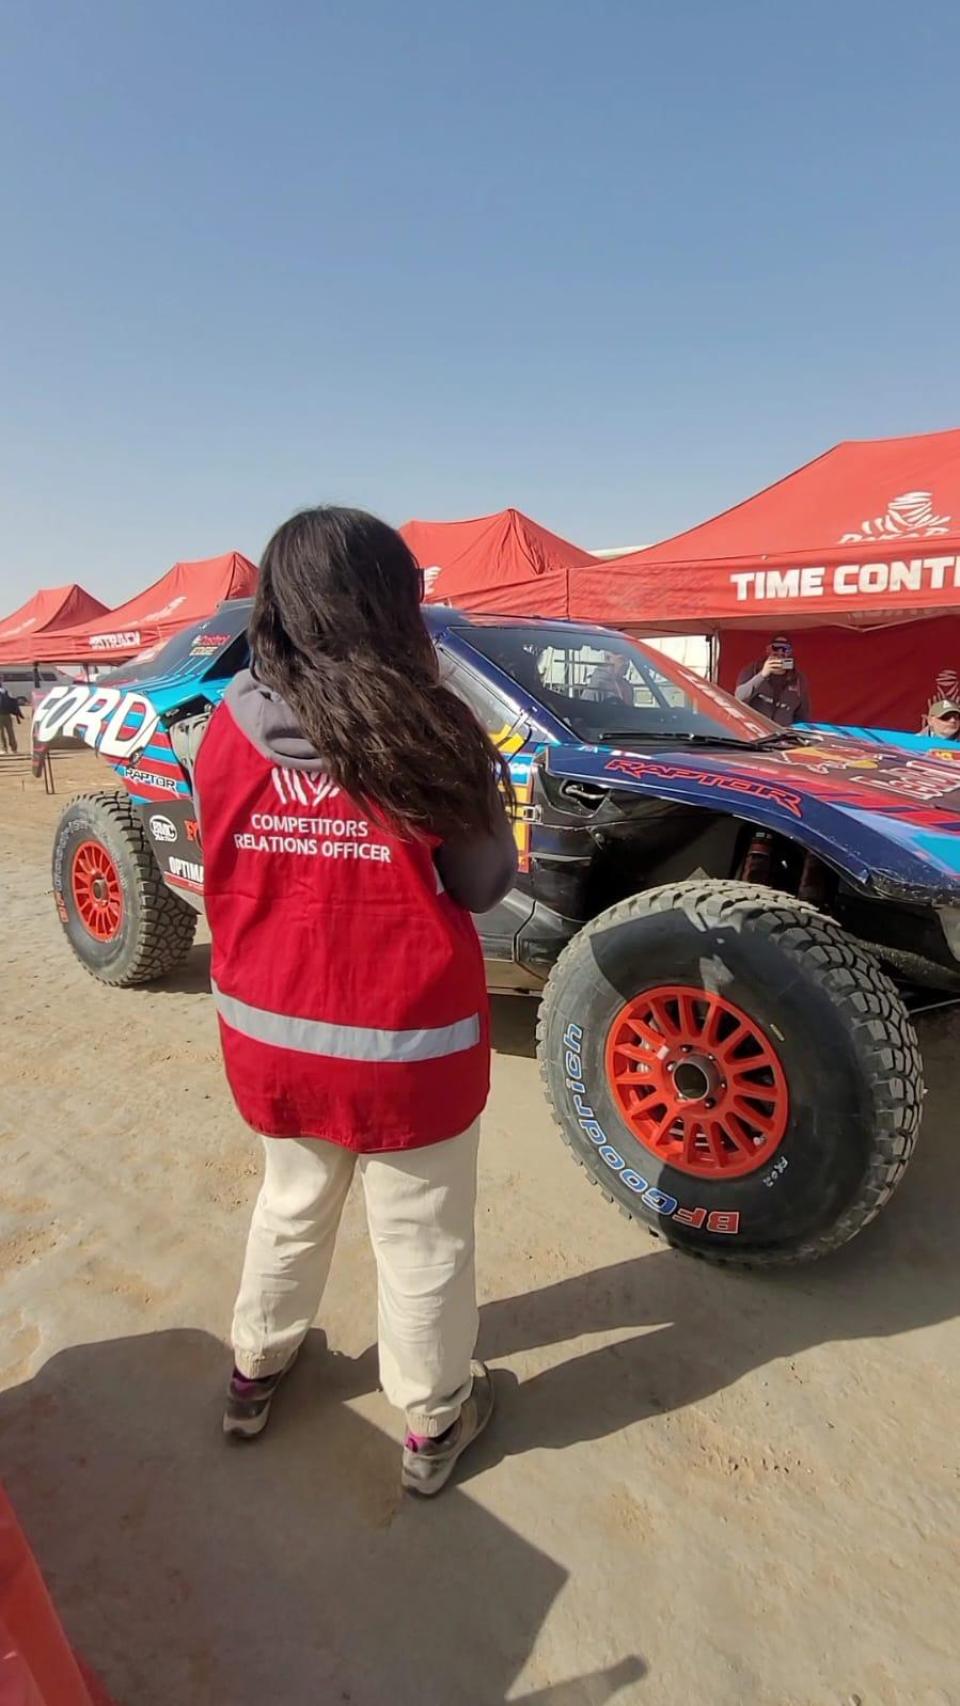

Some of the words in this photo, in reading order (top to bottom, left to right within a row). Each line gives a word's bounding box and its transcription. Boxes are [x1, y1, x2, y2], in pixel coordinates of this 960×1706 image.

[730, 567, 825, 601] TIME
[833, 554, 960, 595] CONT
[32, 686, 160, 758] FORD
[124, 767, 178, 796] RAPTOR
[605, 759, 802, 817] RAPTOR
[234, 833, 318, 855] RELATIONS
[322, 842, 391, 863] OFFICER
[251, 813, 368, 837] COMPETITORS
[562, 1023, 741, 1235] BFGoodrich
